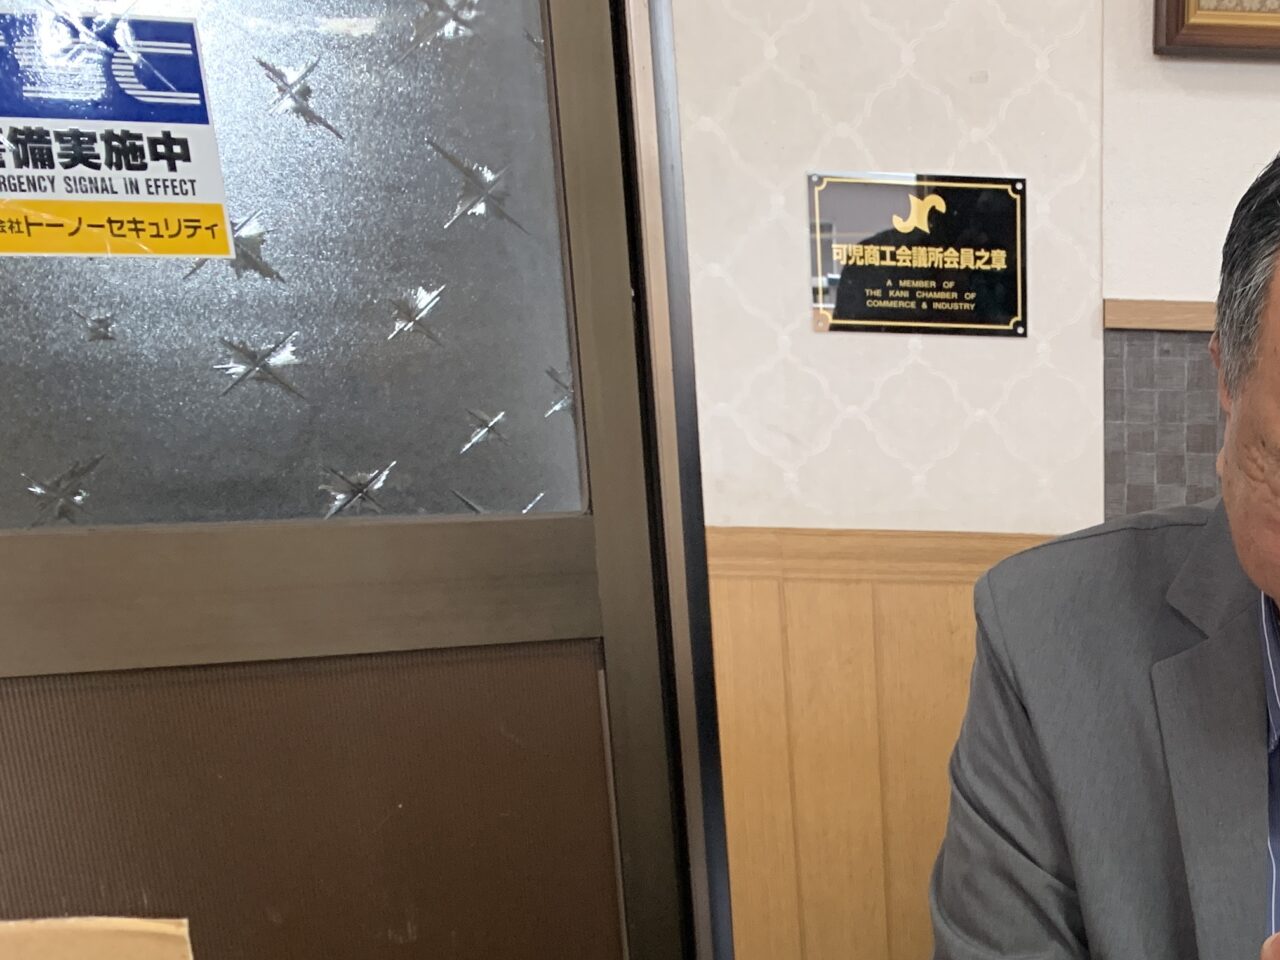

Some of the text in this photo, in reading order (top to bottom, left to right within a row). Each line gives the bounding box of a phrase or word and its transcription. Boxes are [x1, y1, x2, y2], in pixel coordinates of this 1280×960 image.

[64, 176, 118, 195] SIGNAL
[123, 178, 139, 195] IN
[146, 179, 196, 196] EFFECT
[832, 244, 1007, 271] 可児商工会議所会員之章
[899, 280, 936, 288] MEMBER
[943, 281, 955, 289] OF
[865, 289, 977, 300] THE KANI CHAMBER OF
[866, 300, 916, 308] COMMERCE
[933, 302, 976, 310] INDUSTRY
